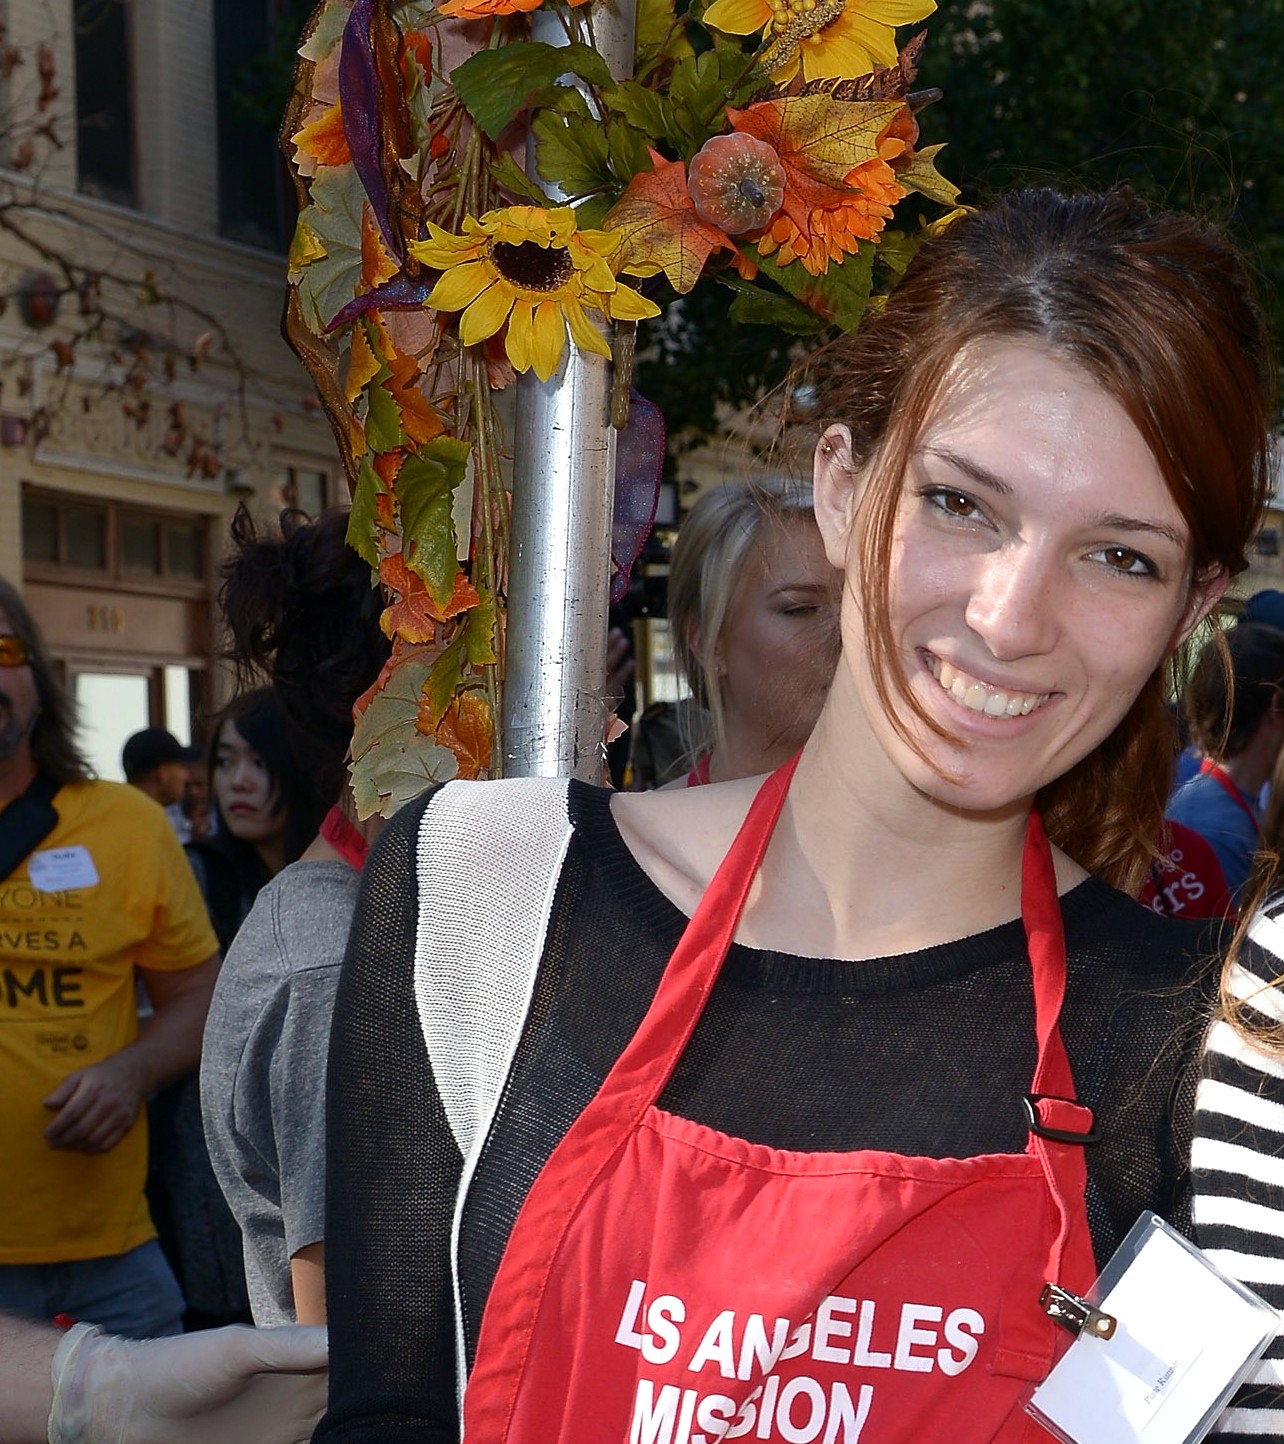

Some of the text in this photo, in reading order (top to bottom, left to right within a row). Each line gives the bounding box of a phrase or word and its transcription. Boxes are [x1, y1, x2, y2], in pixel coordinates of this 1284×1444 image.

[0, 931, 88, 950] VES A
[0, 966, 84, 1008] ME
[614, 1279, 686, 1365] LS
